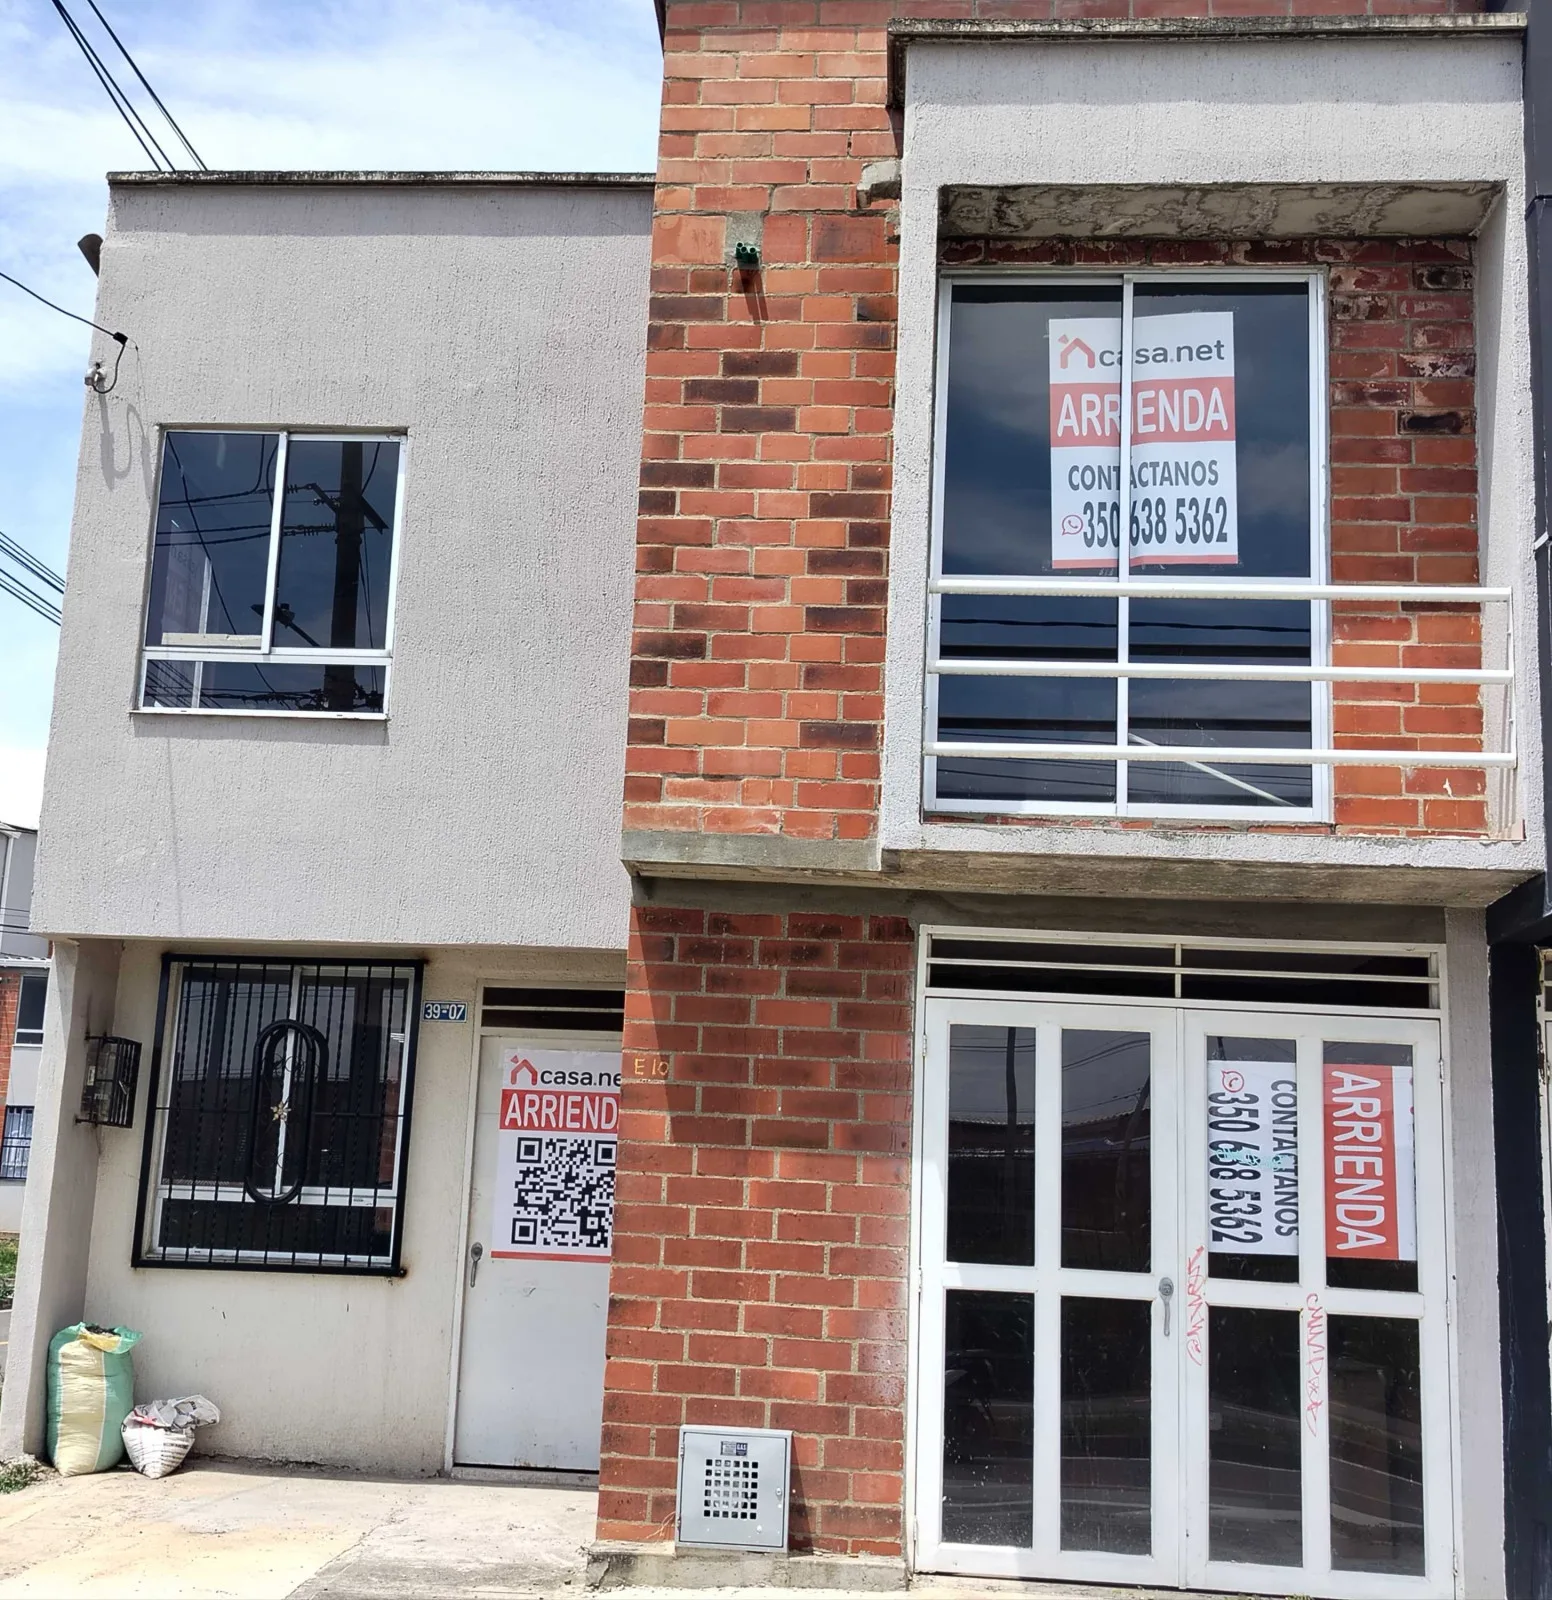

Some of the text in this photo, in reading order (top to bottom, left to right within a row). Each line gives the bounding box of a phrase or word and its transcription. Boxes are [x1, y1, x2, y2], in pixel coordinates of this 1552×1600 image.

[1057, 387, 1229, 437] ARRENDA
[1083, 496, 1228, 548] 350 638 5362
[425, 1003, 465, 1020] 39-07
[540, 1068, 621, 1087] casa.ne
[504, 1093, 620, 1130] ARRIEND
[1208, 1092, 1260, 1133] 350
[1331, 1070, 1387, 1251] ARRIENDA
[1209, 1187, 1264, 1244] 5362
